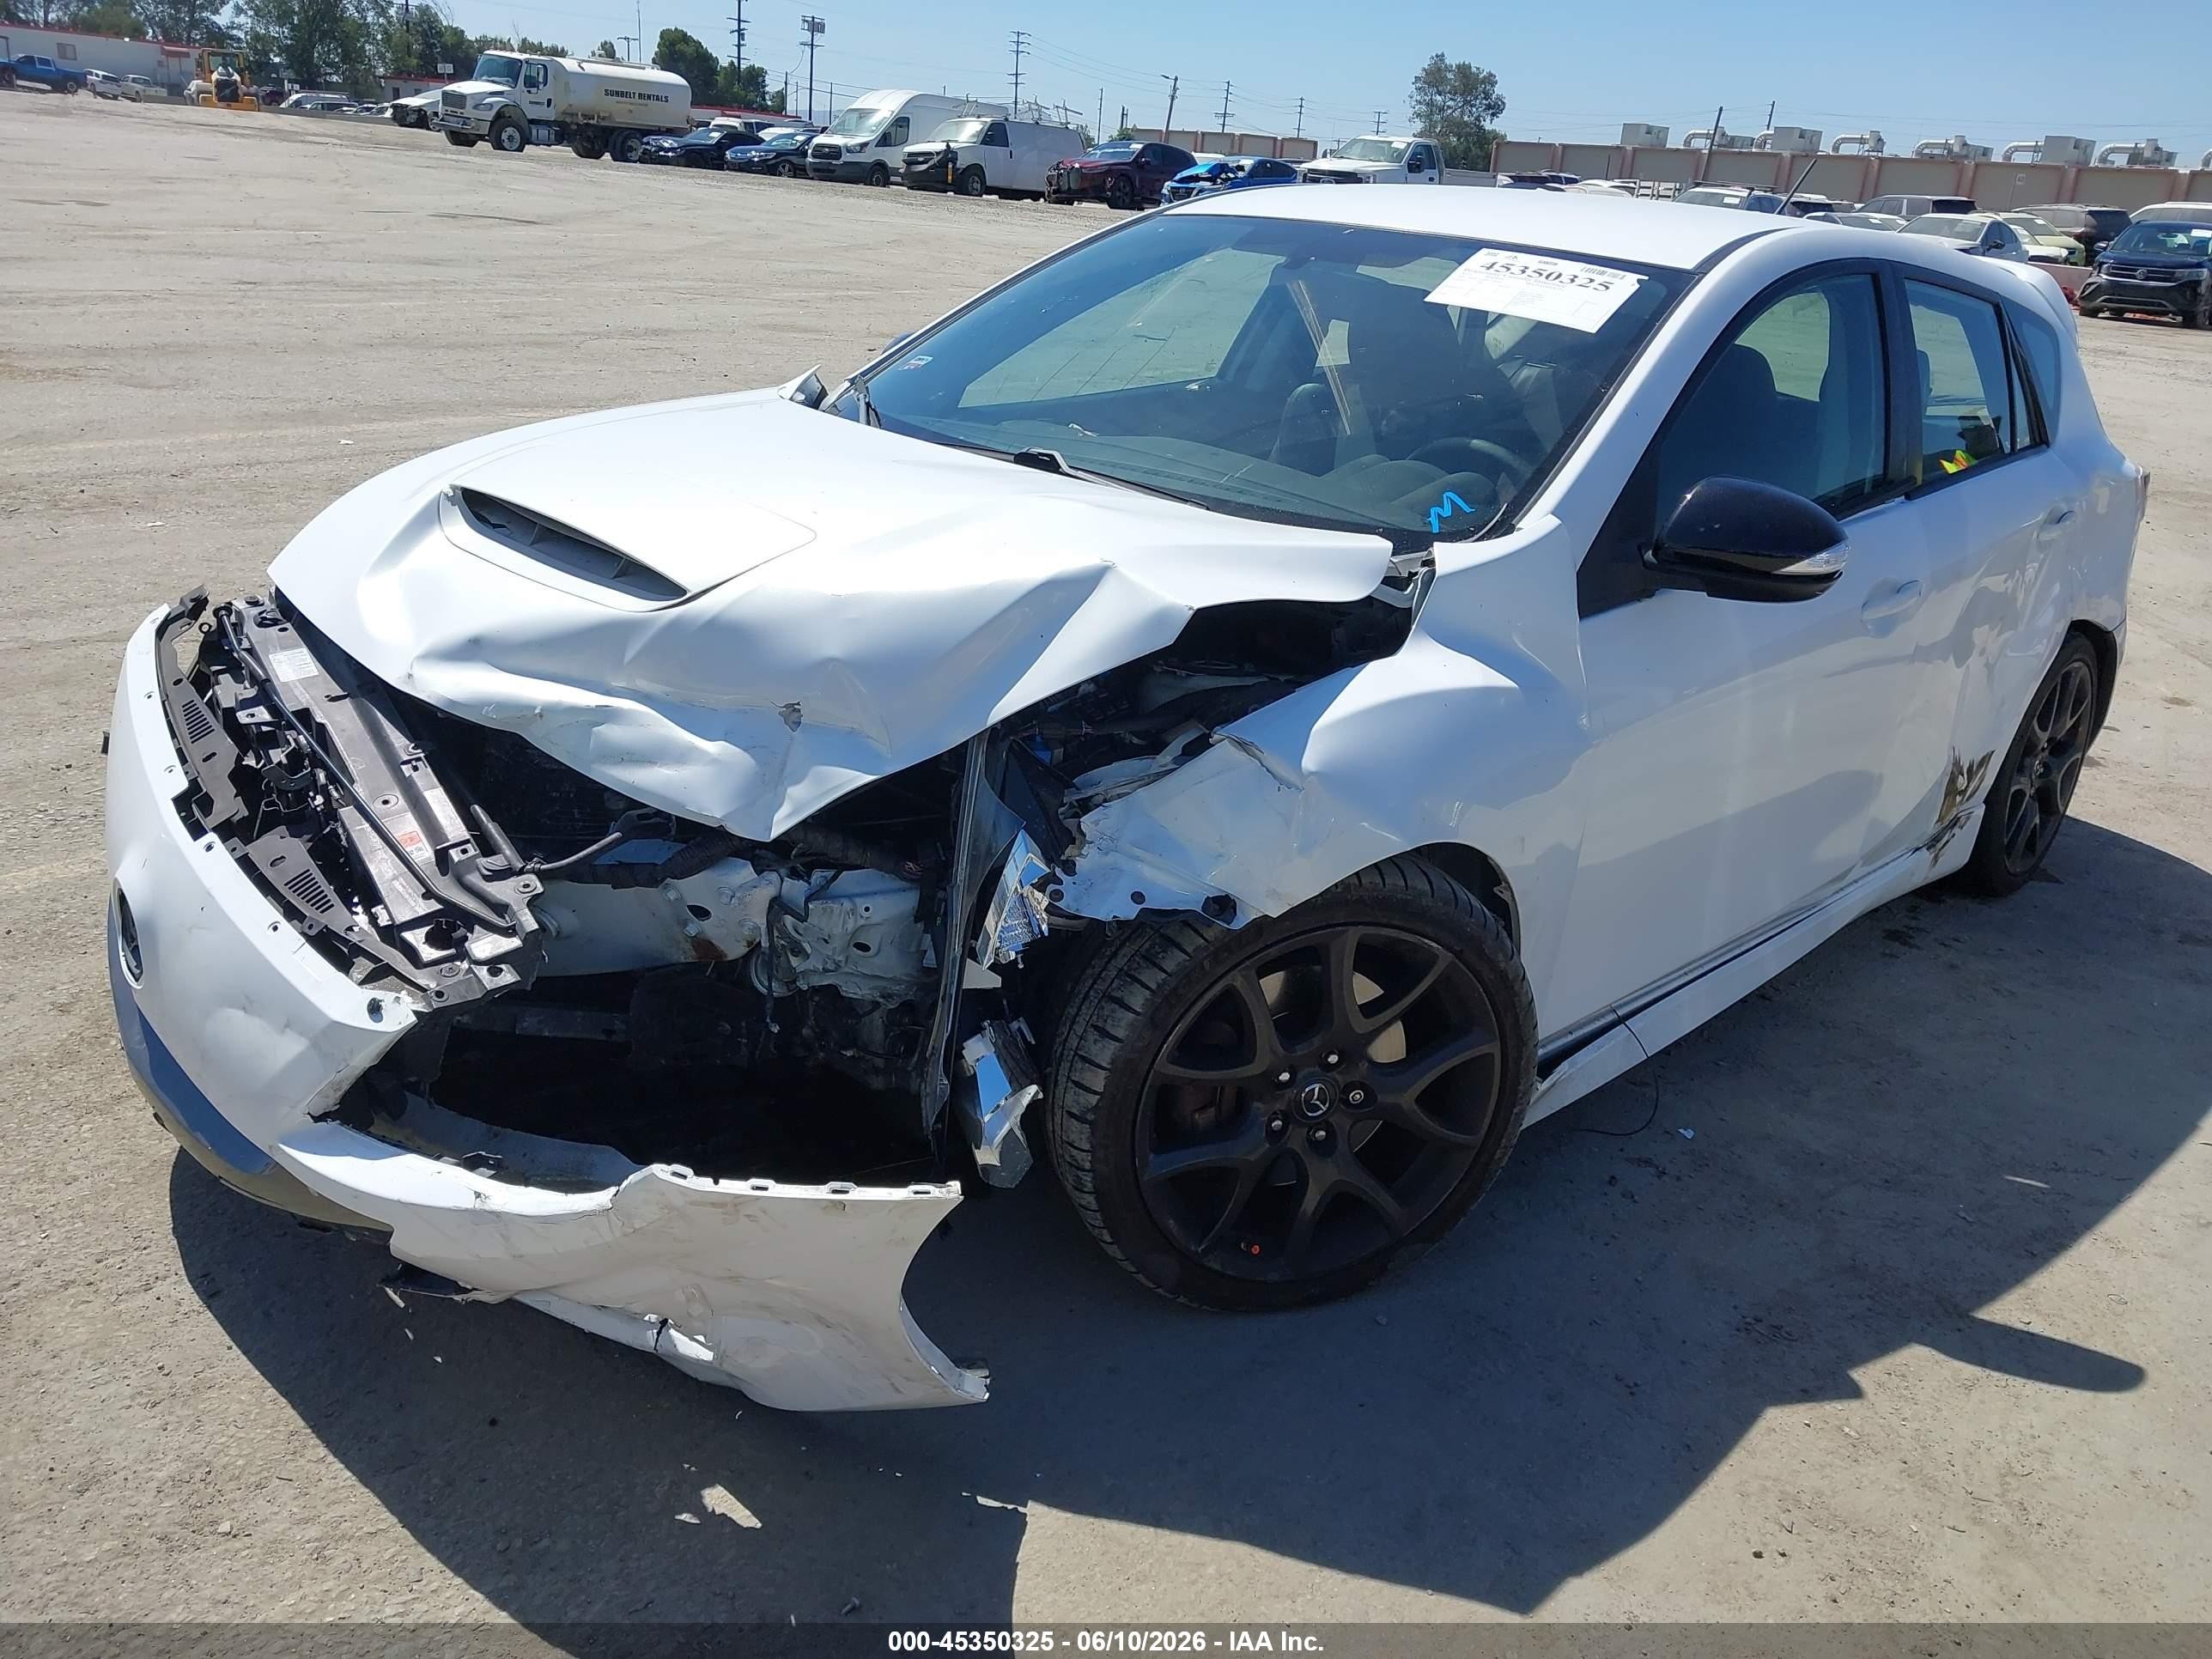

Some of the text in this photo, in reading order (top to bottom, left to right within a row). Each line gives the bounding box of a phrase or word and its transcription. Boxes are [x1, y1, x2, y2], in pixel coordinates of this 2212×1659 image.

[604, 88, 670, 103] SUNBELT RENTALS
[1480, 260, 1615, 292] 45350325
